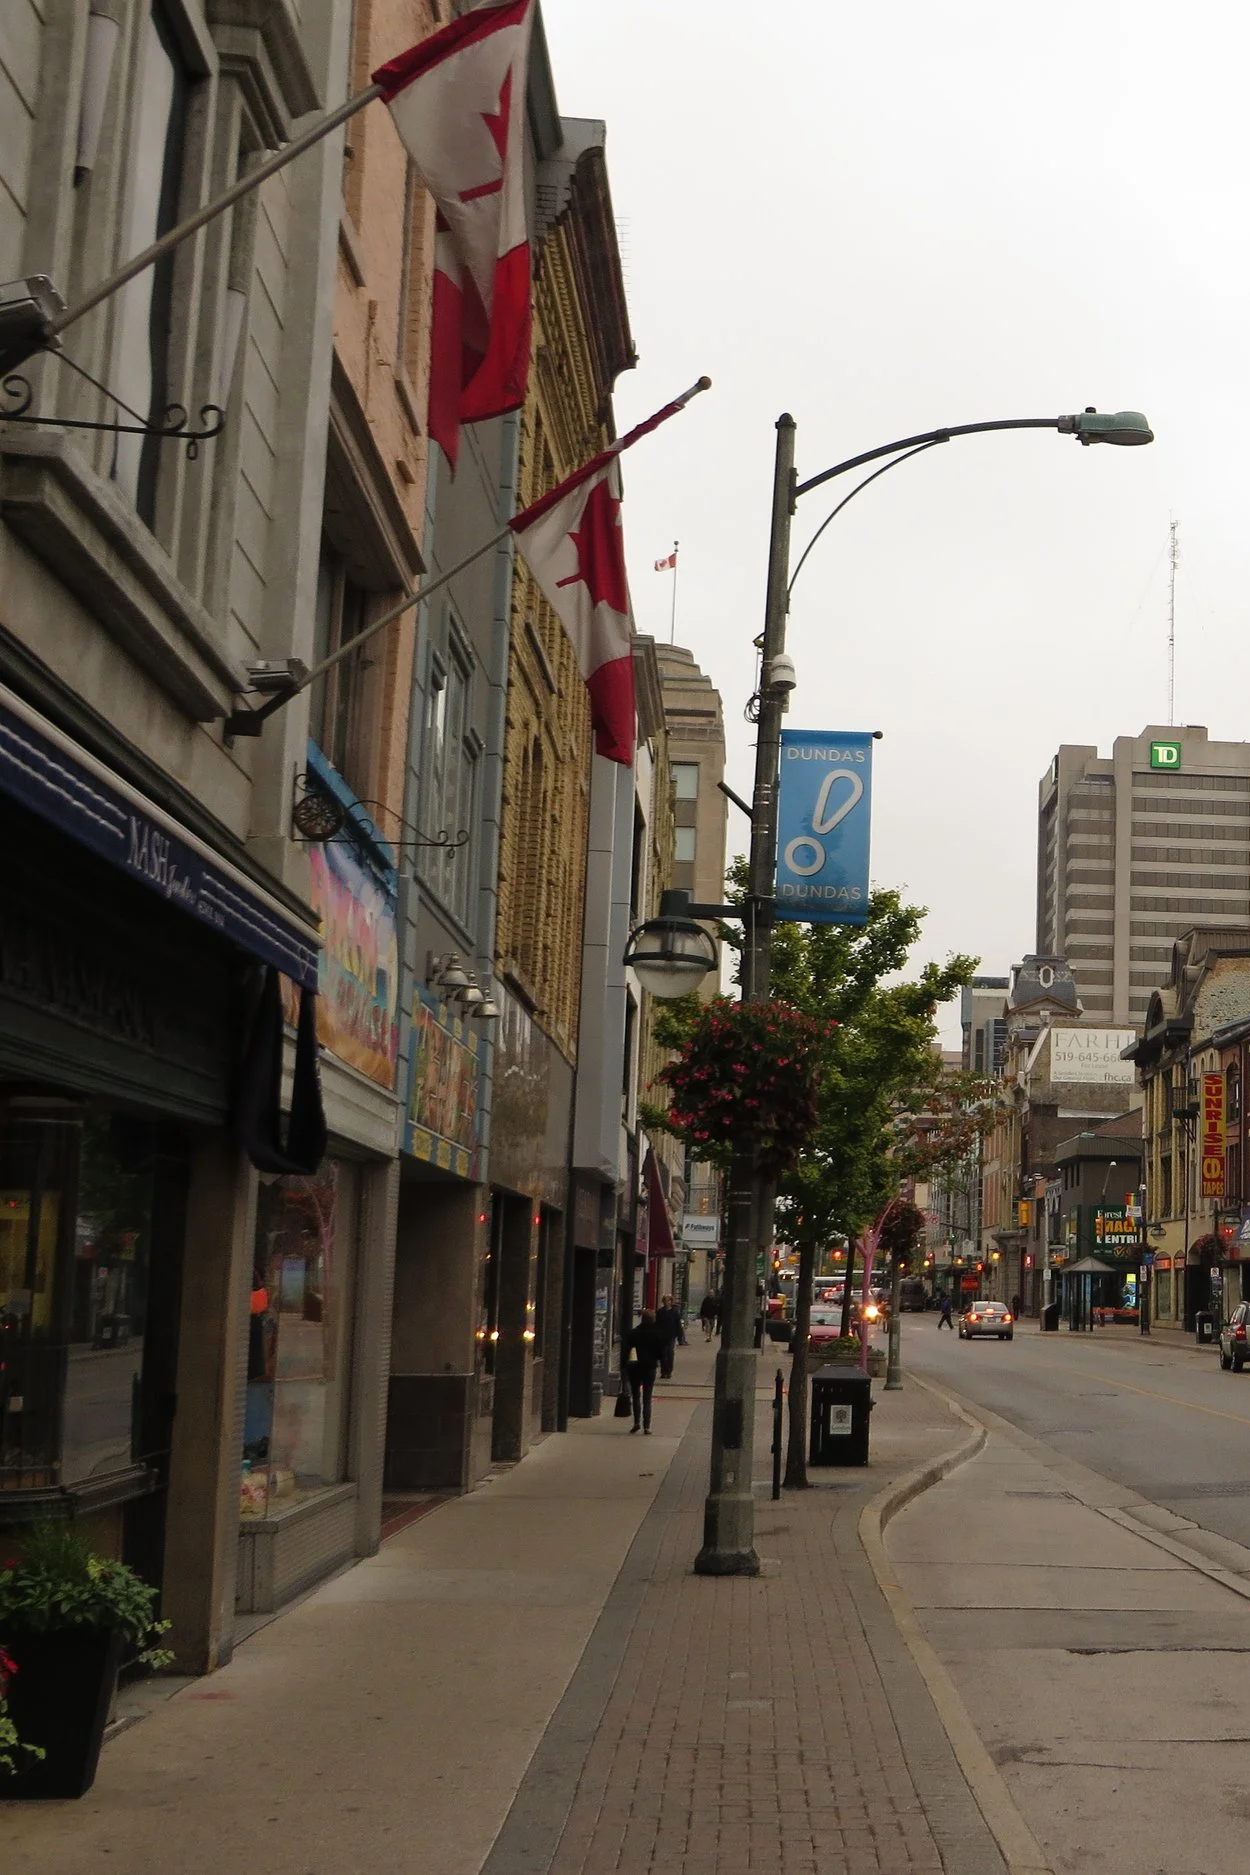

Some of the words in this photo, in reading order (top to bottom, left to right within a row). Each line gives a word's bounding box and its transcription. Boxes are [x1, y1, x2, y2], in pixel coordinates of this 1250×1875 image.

[786, 748, 866, 763] DUNDAS
[1153, 746, 1178, 763] TD
[127, 815, 171, 886] NASH
[782, 884, 862, 900] DUNDAS
[1055, 1032, 1131, 1049] FARHI
[1055, 1051, 1131, 1063] 519-645-66
[1104, 1072, 1132, 1082] fhc.ca
[1203, 1074, 1223, 1155] SUNRISE
[1202, 1181, 1225, 1196] TAPES
